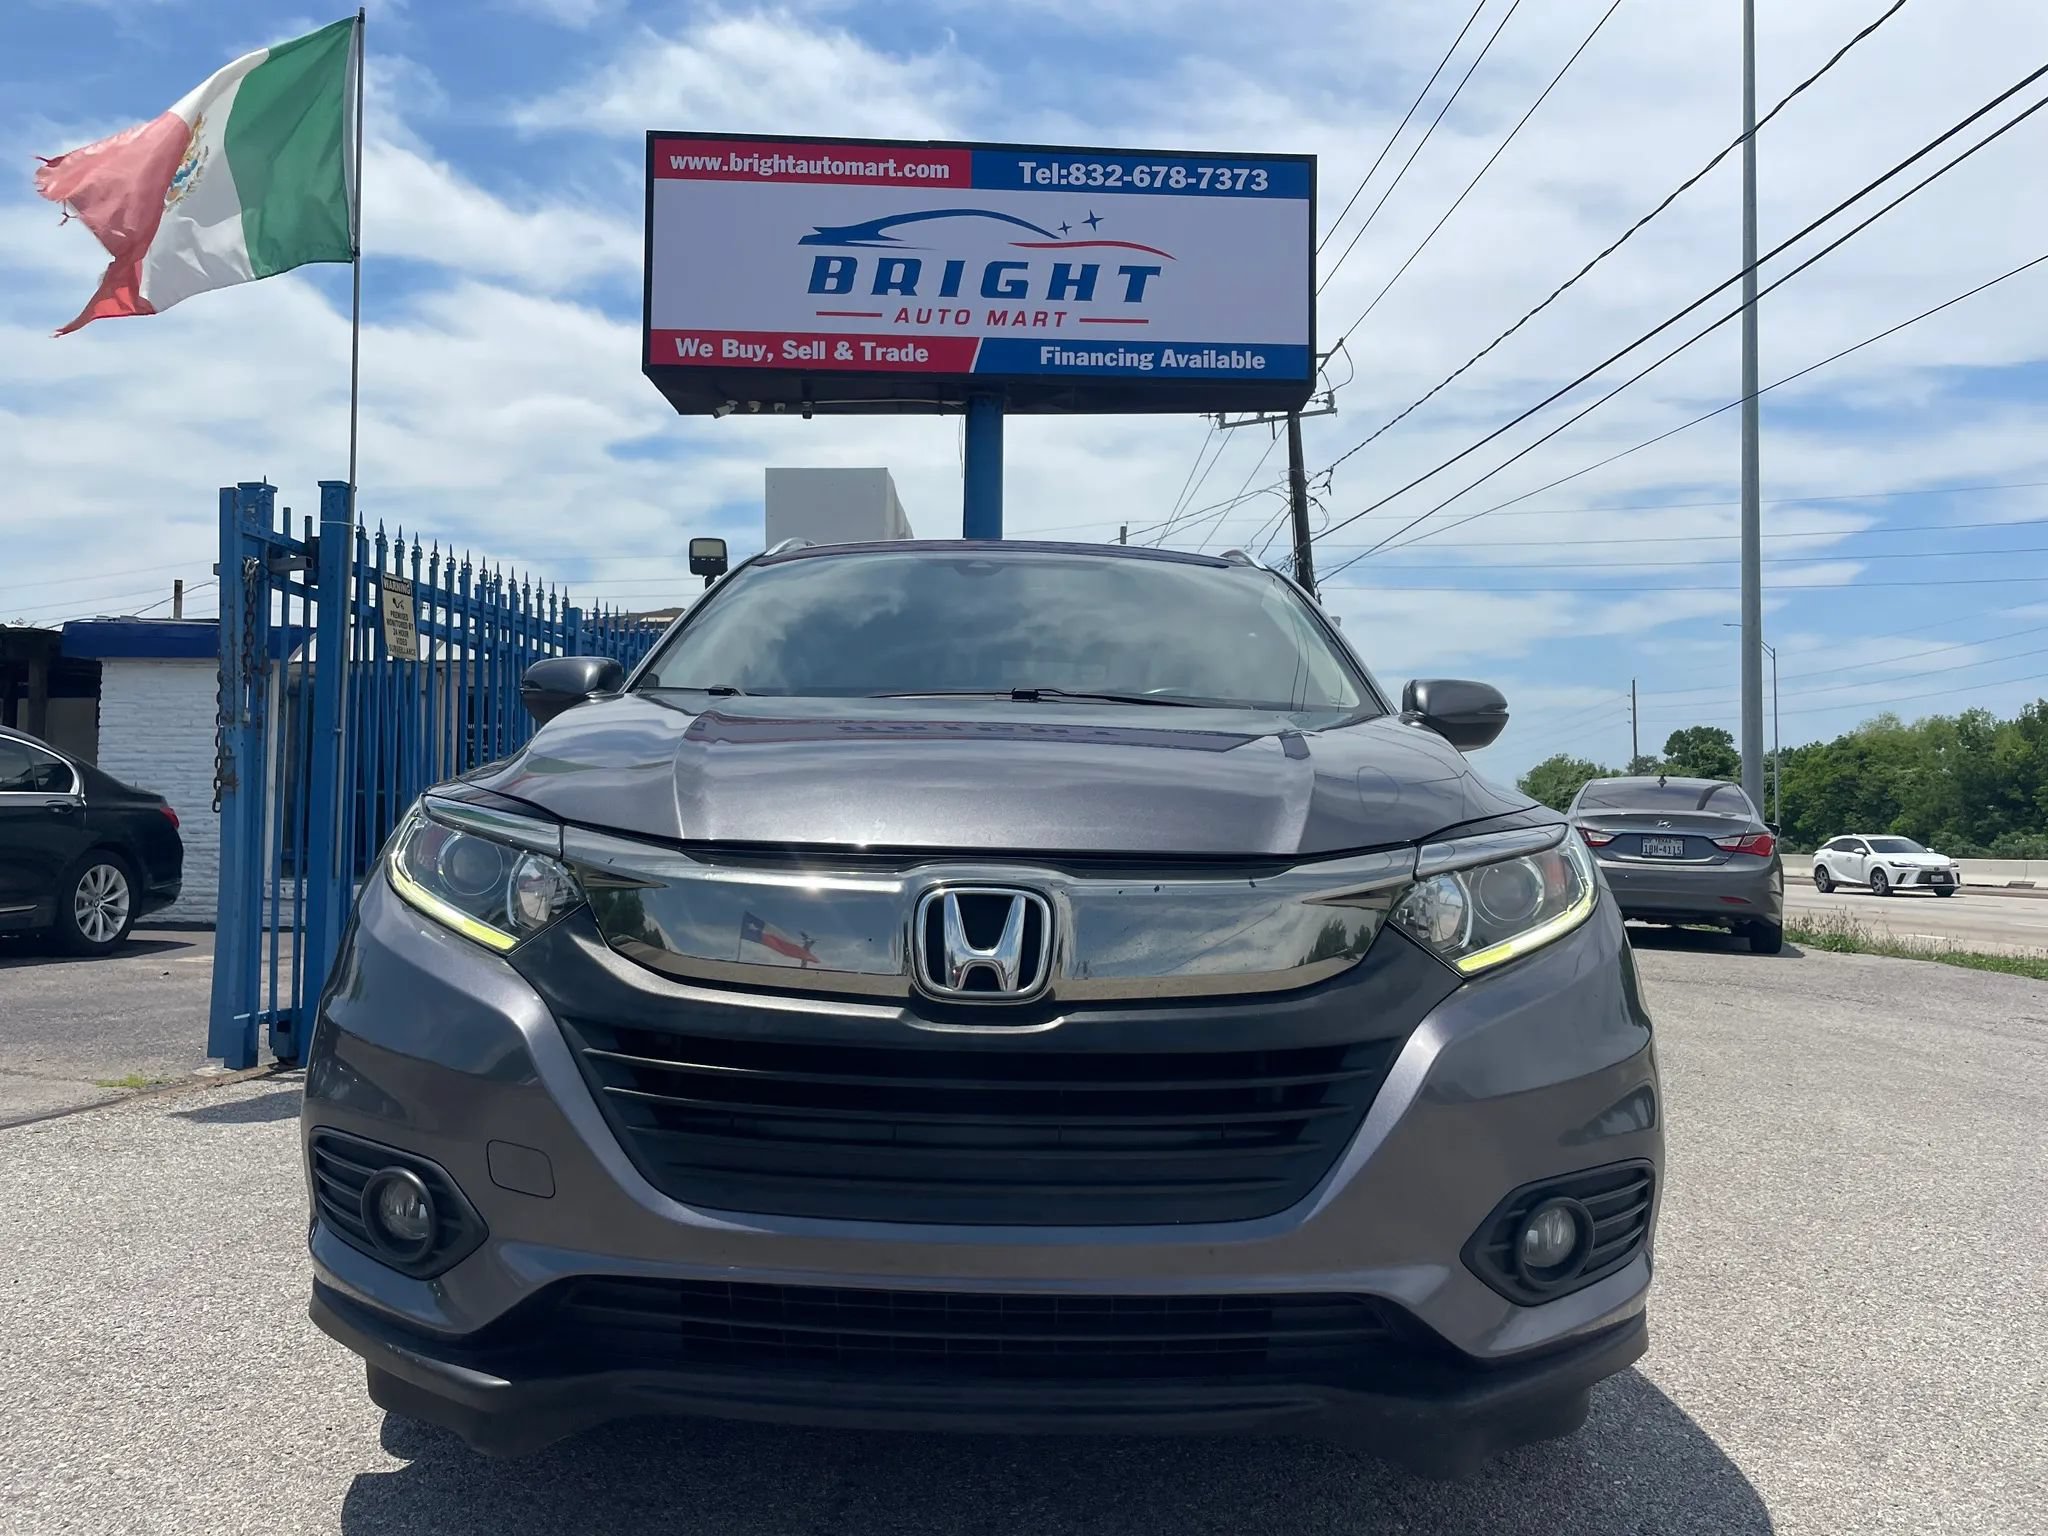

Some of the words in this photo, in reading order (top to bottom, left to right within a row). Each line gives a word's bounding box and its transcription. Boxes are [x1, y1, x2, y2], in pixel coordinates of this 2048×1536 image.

[670, 152, 950, 179] www.brightautomart.com
[1018, 161, 1269, 192] Tel:832-678-7373
[807, 255, 1162, 303] BRIGHT
[894, 307, 972, 326] AUTO
[986, 310, 1068, 328] MART
[675, 337, 714, 359] We
[721, 338, 774, 363] Buy,
[782, 339, 827, 361] Sell
[834, 341, 854, 361] &
[860, 341, 929, 363] Trade
[1040, 346, 1155, 371] Financing
[1160, 349, 1266, 370] Available
[384, 580, 411, 594] WARNING
[386, 618, 408, 630] MONITORED
[390, 610, 409, 621] PREMISES
[393, 628, 399, 636] 24
[399, 629, 409, 638] HOUR
[396, 637, 408, 646] VIDEO
